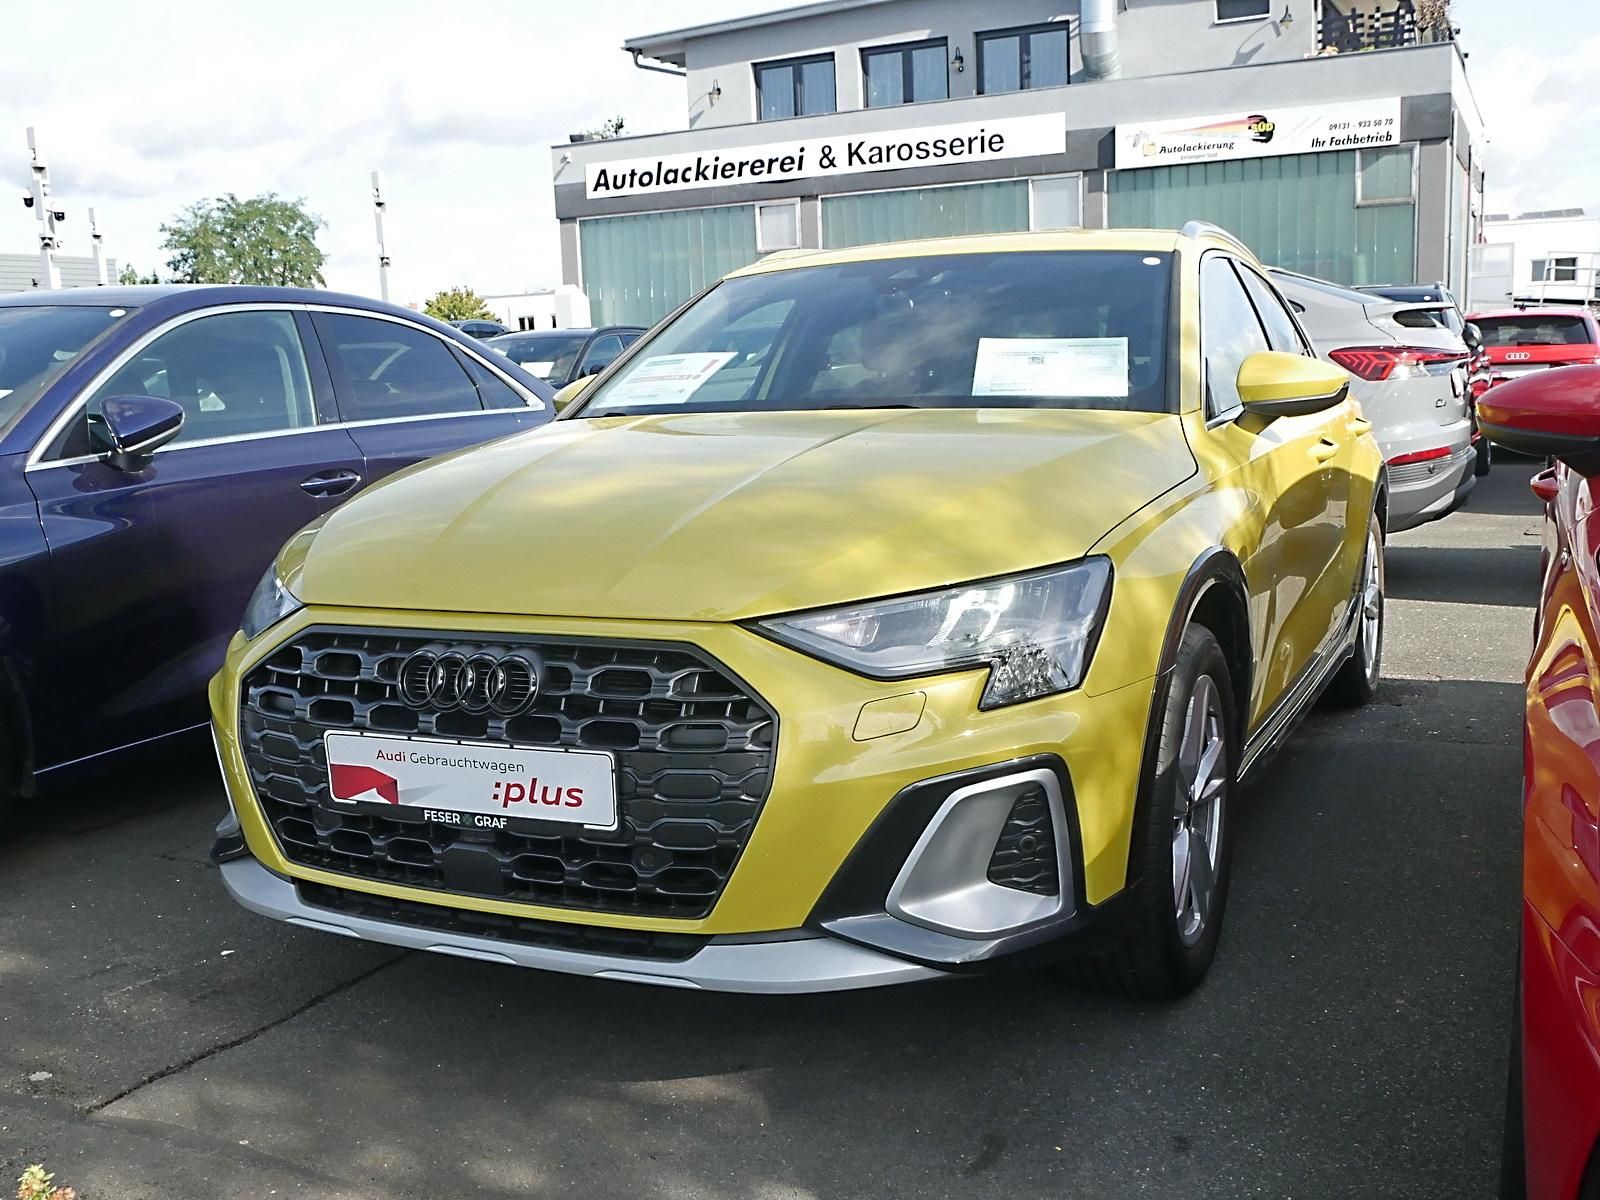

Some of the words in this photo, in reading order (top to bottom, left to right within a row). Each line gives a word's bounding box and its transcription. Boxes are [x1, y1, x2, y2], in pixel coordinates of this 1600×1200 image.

[1328, 122, 1350, 131] 09131
[1358, 119, 1371, 128] 933
[1373, 119, 1382, 127] 50
[1384, 118, 1394, 126] 70
[1159, 141, 1235, 154] Autolackierung
[1311, 137, 1326, 148] Ihr
[1329, 130, 1393, 147] Fachbetrieb
[592, 146, 805, 192] Autolackiererei
[818, 144, 838, 169] &
[847, 128, 1005, 167] Karosserie
[376, 749, 406, 762] Audi
[409, 752, 525, 773] Gebrauchtwagen
[423, 809, 461, 825] FESER
[474, 815, 508, 829] GRAF
